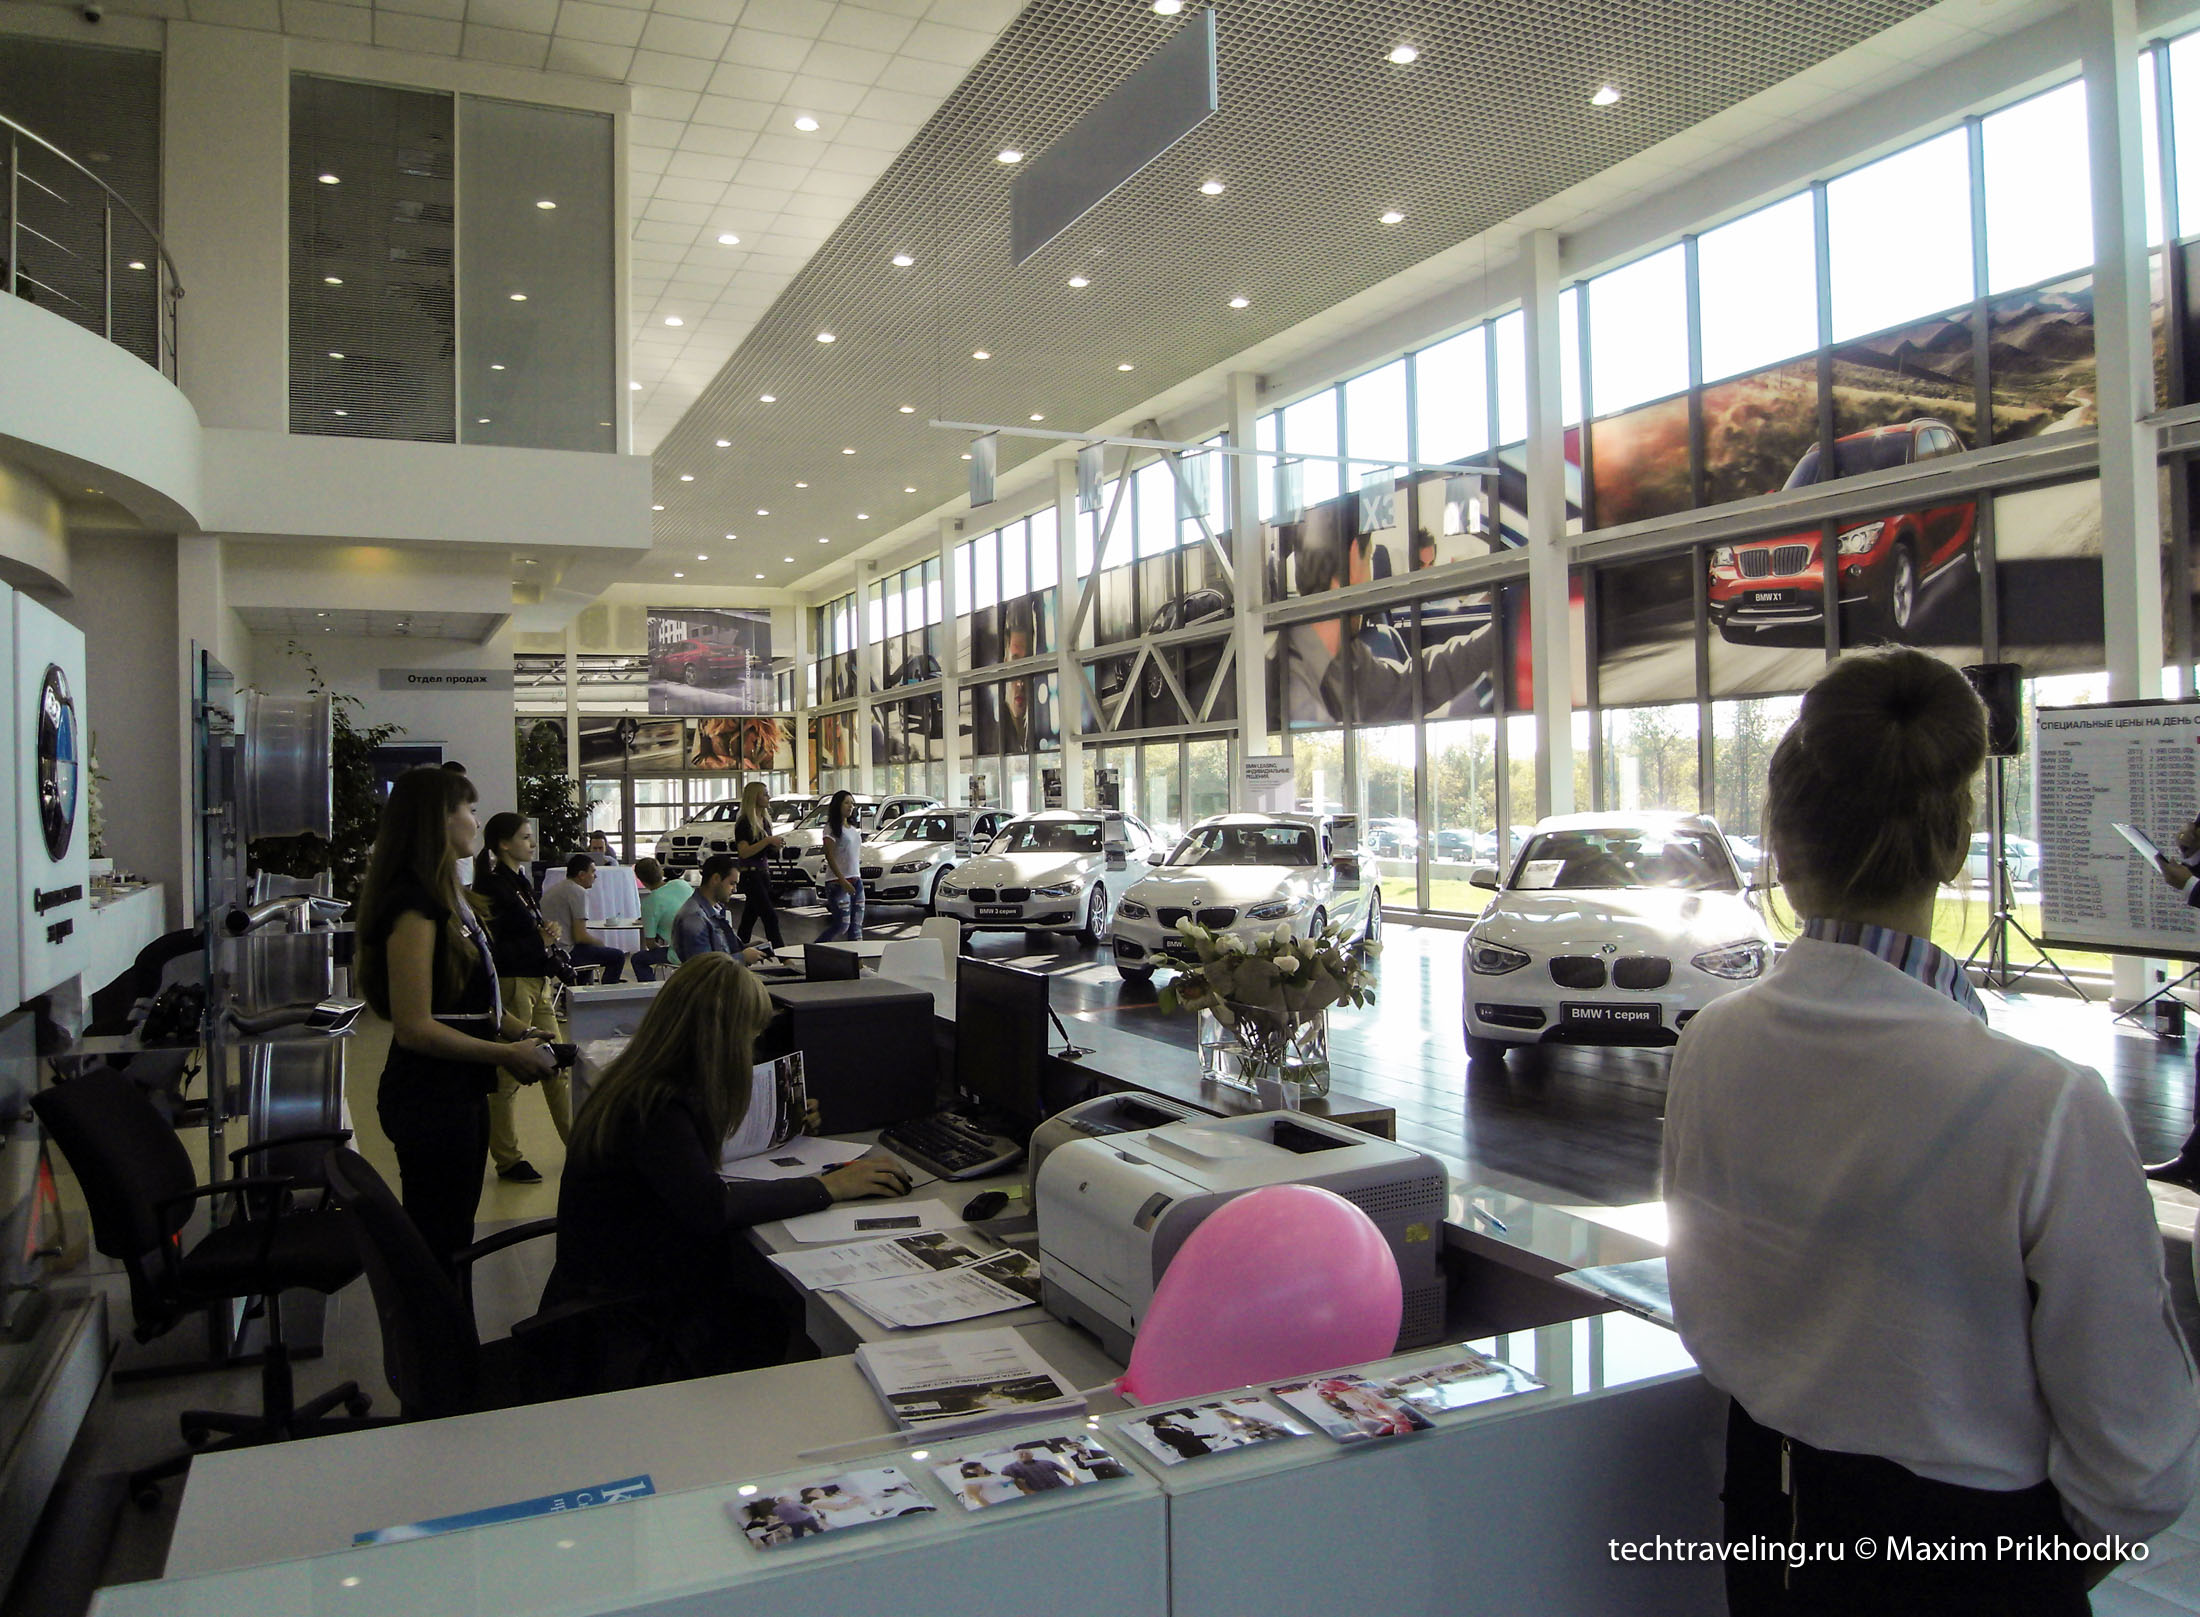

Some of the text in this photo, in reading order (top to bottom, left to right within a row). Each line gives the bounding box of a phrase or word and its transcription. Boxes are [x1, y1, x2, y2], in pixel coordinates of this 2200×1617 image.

[1362, 493, 1395, 533] X3
[1755, 592, 1782, 602] BMW X1
[407, 674, 488, 685] Отдел продаж
[2040, 719, 2113, 730] СПЕЦИАЛЬНЫЕ
[2115, 718, 2144, 729] ЦЕНЫ
[2146, 717, 2161, 726] НА
[2162, 716, 2192, 727] ДЕНЬ
[1166, 940, 1183, 948] BMW
[1571, 1008, 1650, 1022] BMW 1 серия
